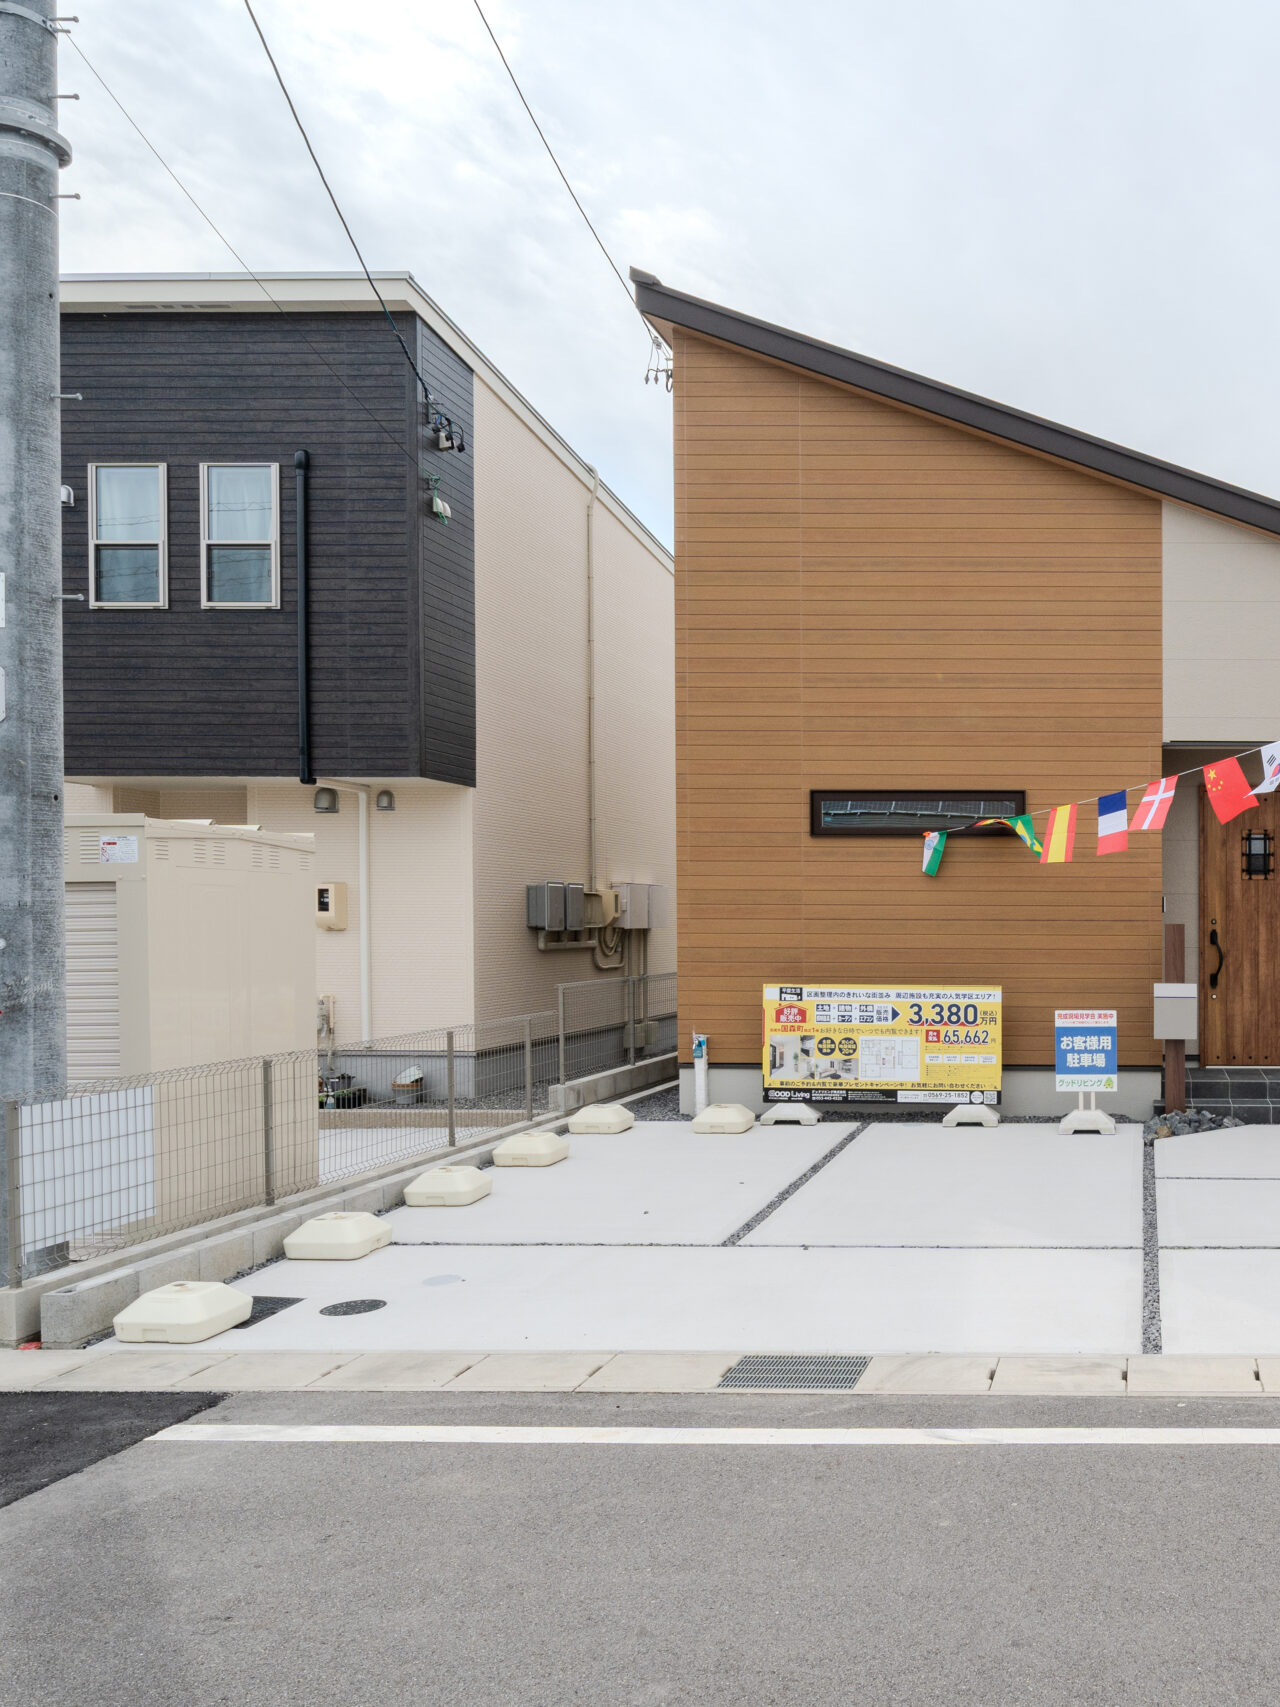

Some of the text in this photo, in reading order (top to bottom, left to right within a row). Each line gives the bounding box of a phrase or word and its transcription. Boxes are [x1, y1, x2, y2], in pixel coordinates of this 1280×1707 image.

[780, 1015, 802, 1023] 販売中
[909, 1003, 979, 1025] 3,380
[980, 1017, 997, 1026] 万円
[943, 1029, 990, 1044] 65,662
[1060, 1035, 1112, 1051] お客様用
[1066, 1053, 1106, 1067] 駐車場
[1058, 1079, 1103, 1088] グッドリビング
[791, 1090, 810, 1099] Living
